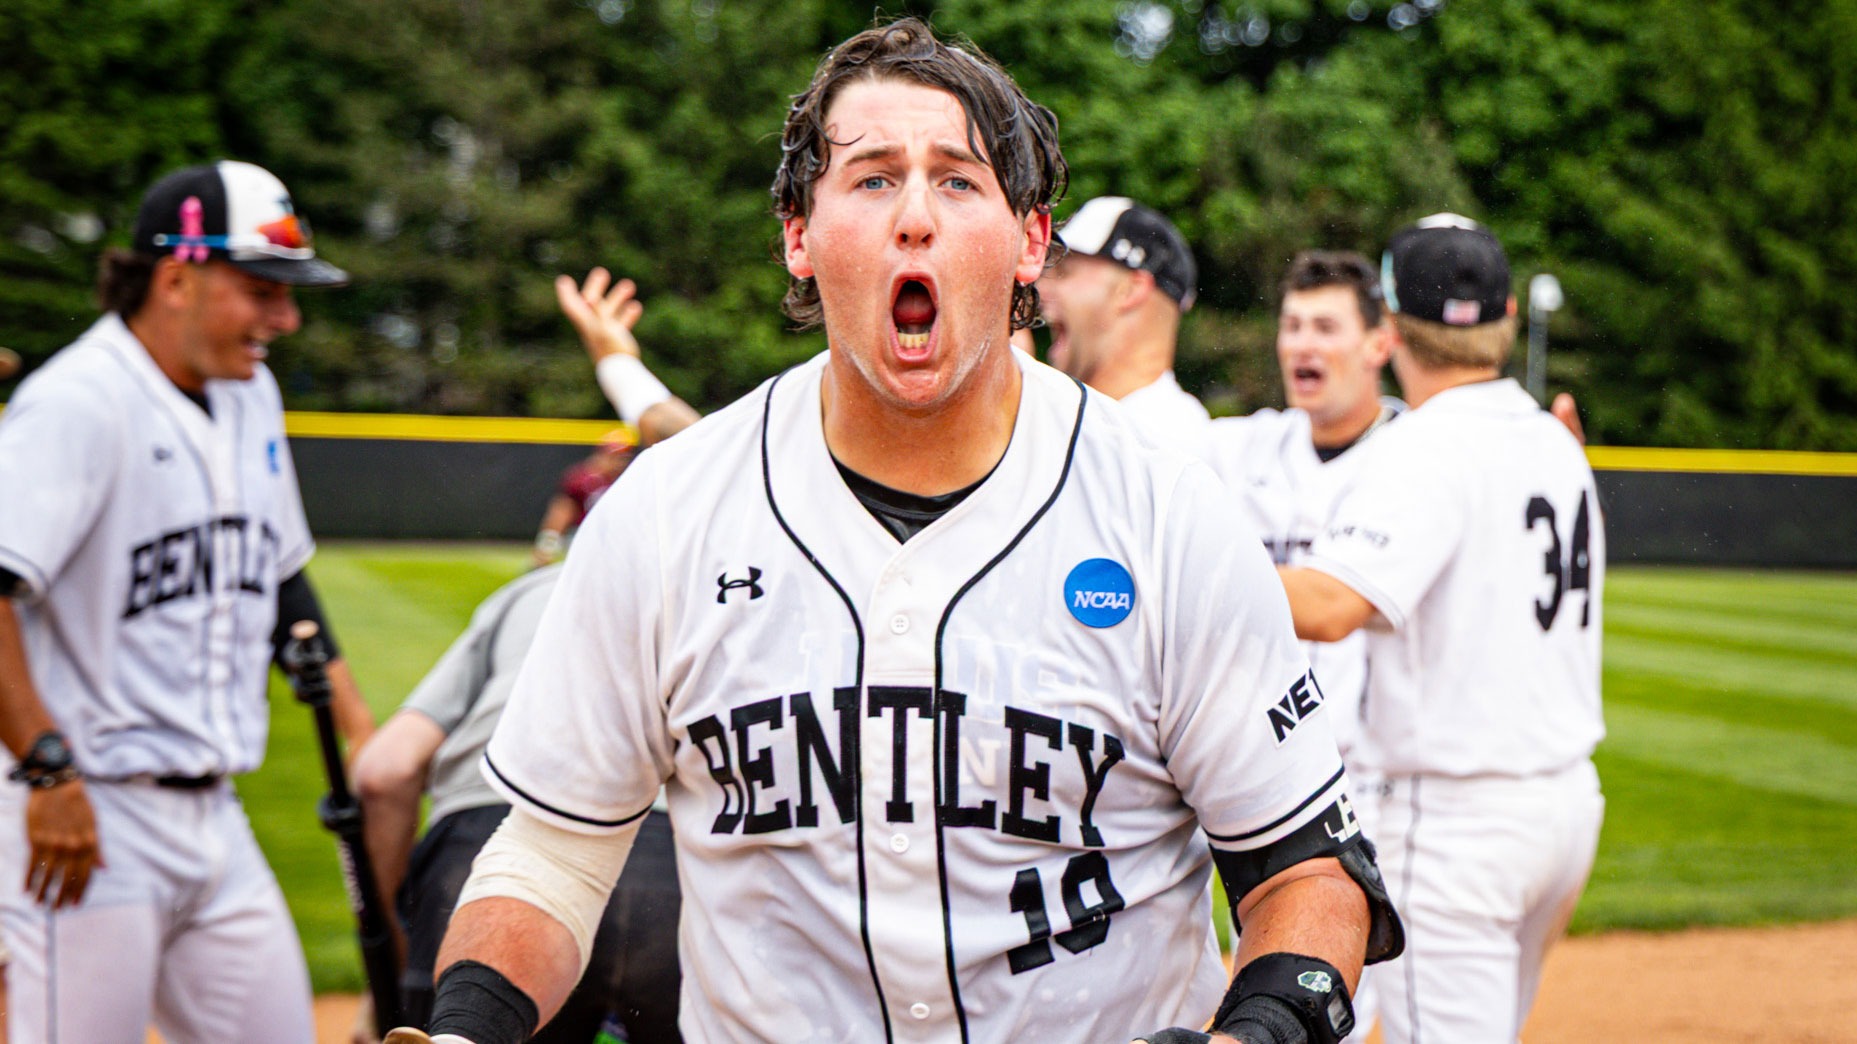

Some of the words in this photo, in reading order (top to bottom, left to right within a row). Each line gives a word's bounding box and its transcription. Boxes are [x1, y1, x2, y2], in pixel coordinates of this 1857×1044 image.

[121, 517, 281, 618] BENTL
[1074, 590, 1130, 610] NCAA
[1526, 489, 1590, 632] 34
[687, 686, 1126, 847] BENTLEY
